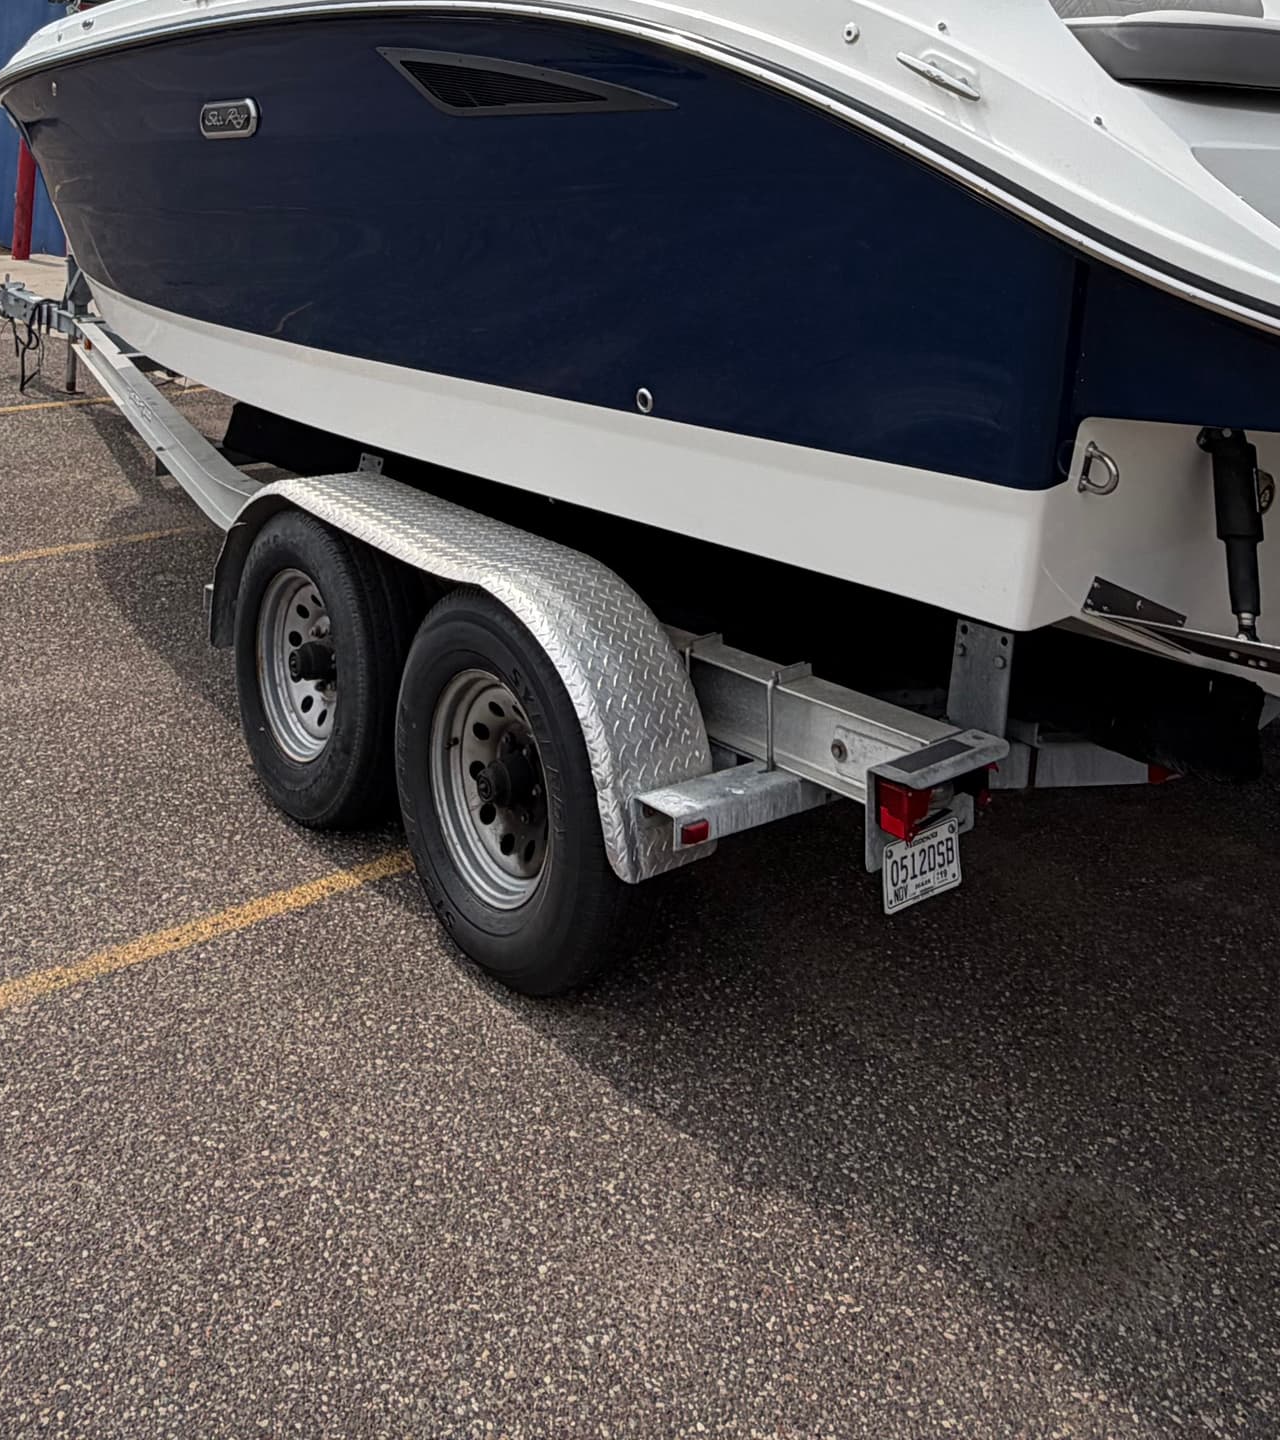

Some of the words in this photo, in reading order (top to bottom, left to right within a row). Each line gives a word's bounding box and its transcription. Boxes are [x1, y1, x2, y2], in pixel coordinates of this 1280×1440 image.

[224, 108, 248, 128] Ray
[890, 836, 955, 888] 0512DSB
[894, 884, 909, 903] NOV
